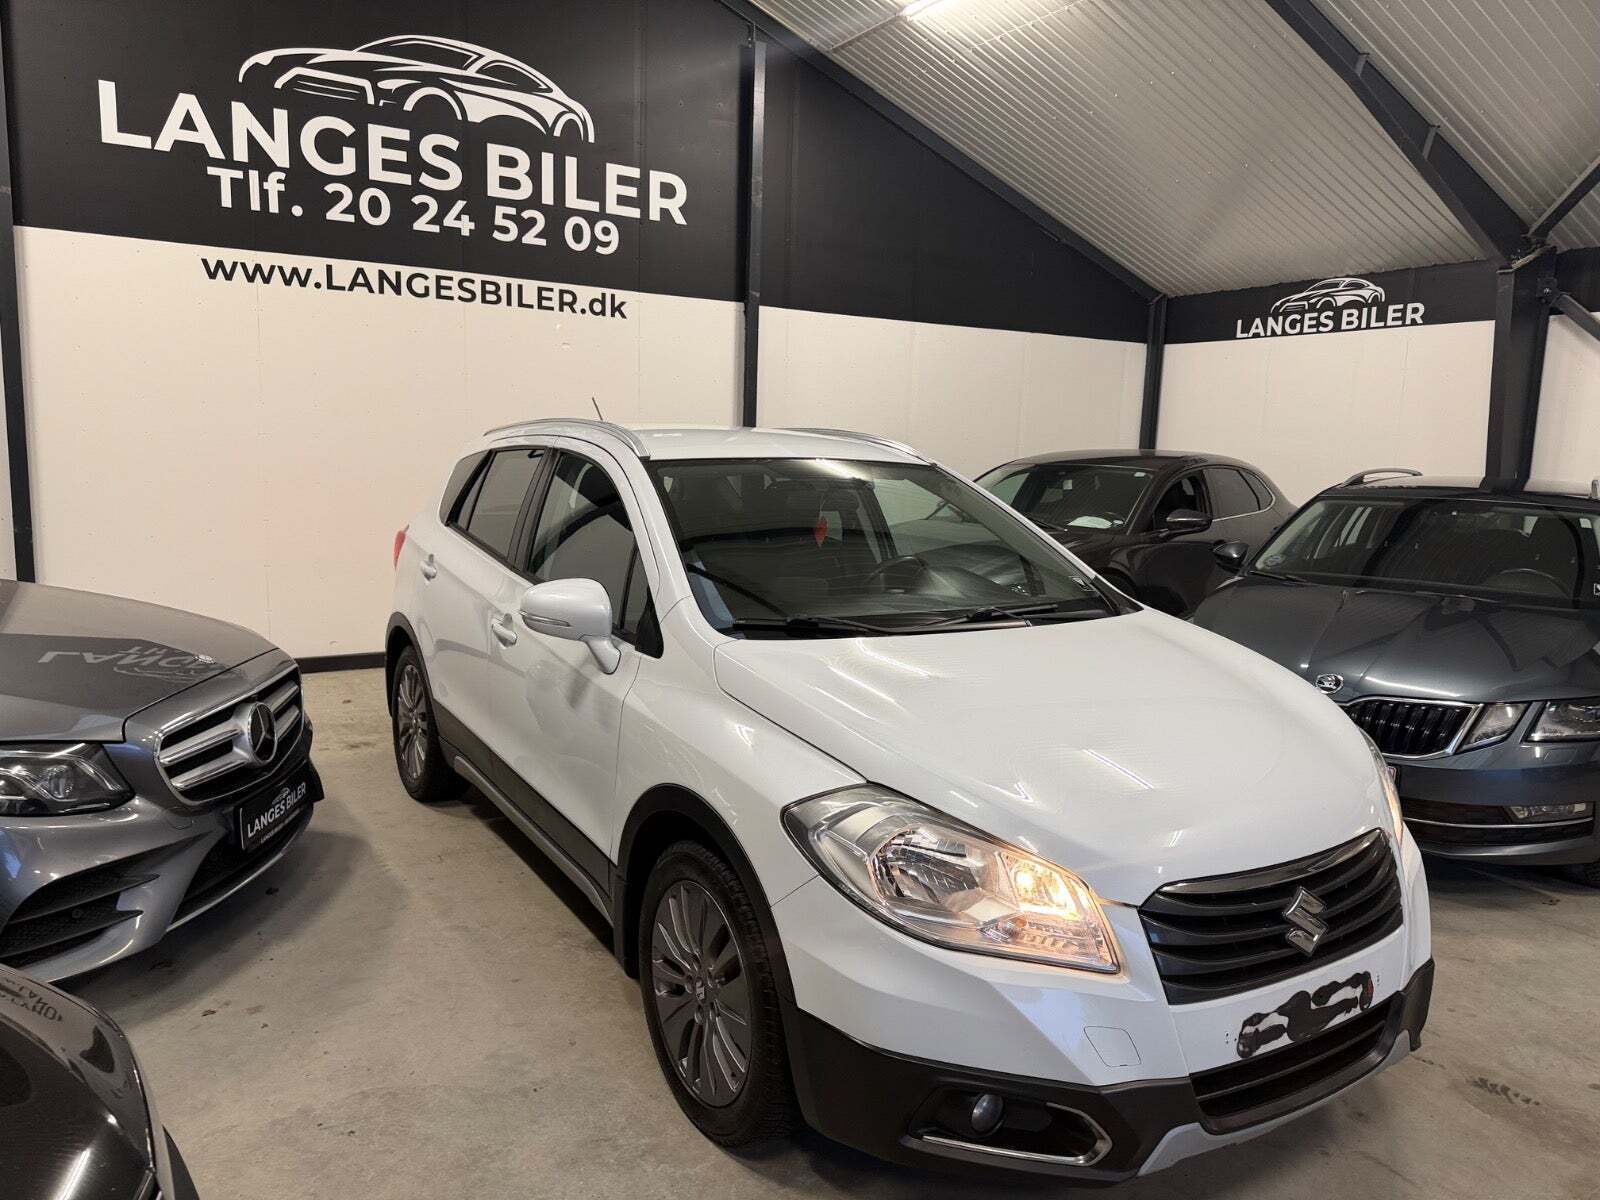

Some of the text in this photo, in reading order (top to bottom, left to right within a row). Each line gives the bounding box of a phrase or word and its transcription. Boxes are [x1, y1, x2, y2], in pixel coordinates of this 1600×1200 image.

[97, 79, 688, 225] LANGES BILER
[206, 166, 620, 255] Tlf. 20 24 52 09
[200, 257, 628, 320] www.LANGESBILER.dk
[1235, 302, 1426, 339] LANGES BILER
[247, 799, 286, 839] LANGES
[286, 781, 307, 810] BILER
